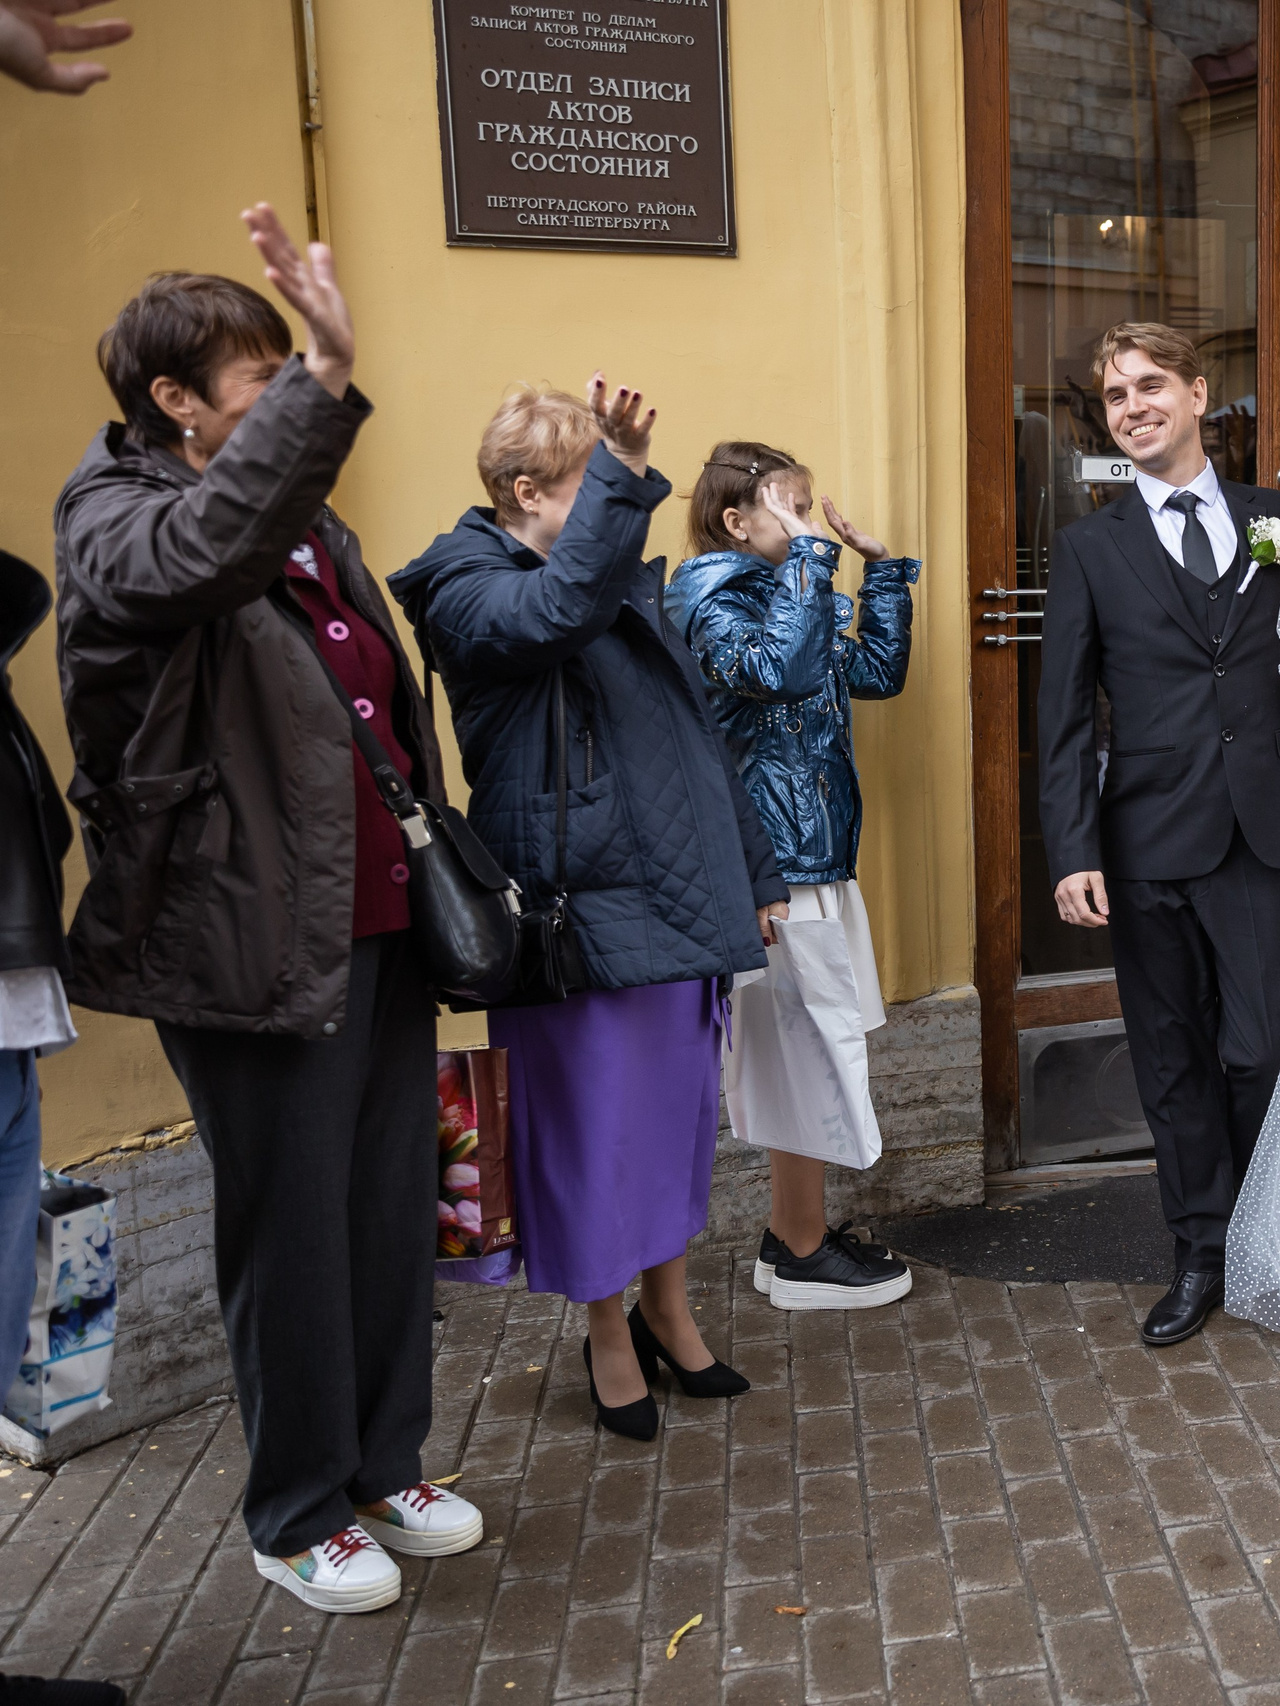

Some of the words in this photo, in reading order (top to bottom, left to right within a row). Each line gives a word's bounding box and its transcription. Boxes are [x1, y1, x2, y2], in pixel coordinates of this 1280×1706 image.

[510, 5, 575, 21] КОМИТЕТ
[582, 12, 601, 23] ПО
[608, 14, 657, 28] ДЕЛАМ
[471, 16, 528, 31] ЗАПИСИ
[534, 22, 579, 36] АКТОВ
[585, 26, 695, 46] ГРАЖДАНСКОГО
[545, 37, 628, 53] СОСТОЯНИЯ
[480, 68, 573, 94] ОТДЕЛ
[589, 77, 691, 103] ЗАПИСИ
[547, 100, 633, 124] АКТОВ
[477, 122, 699, 155] ГРАЖДАНСКОГО
[511, 151, 670, 179] СОСТОЯНИЯ
[487, 195, 629, 214] ПЕТРОГРАДСКОГО
[637, 198, 698, 217] РАЙОНА
[517, 213, 671, 231] САНКТ-ПЕТЕРБУРГА
[1110, 464, 1132, 477] ОТ
